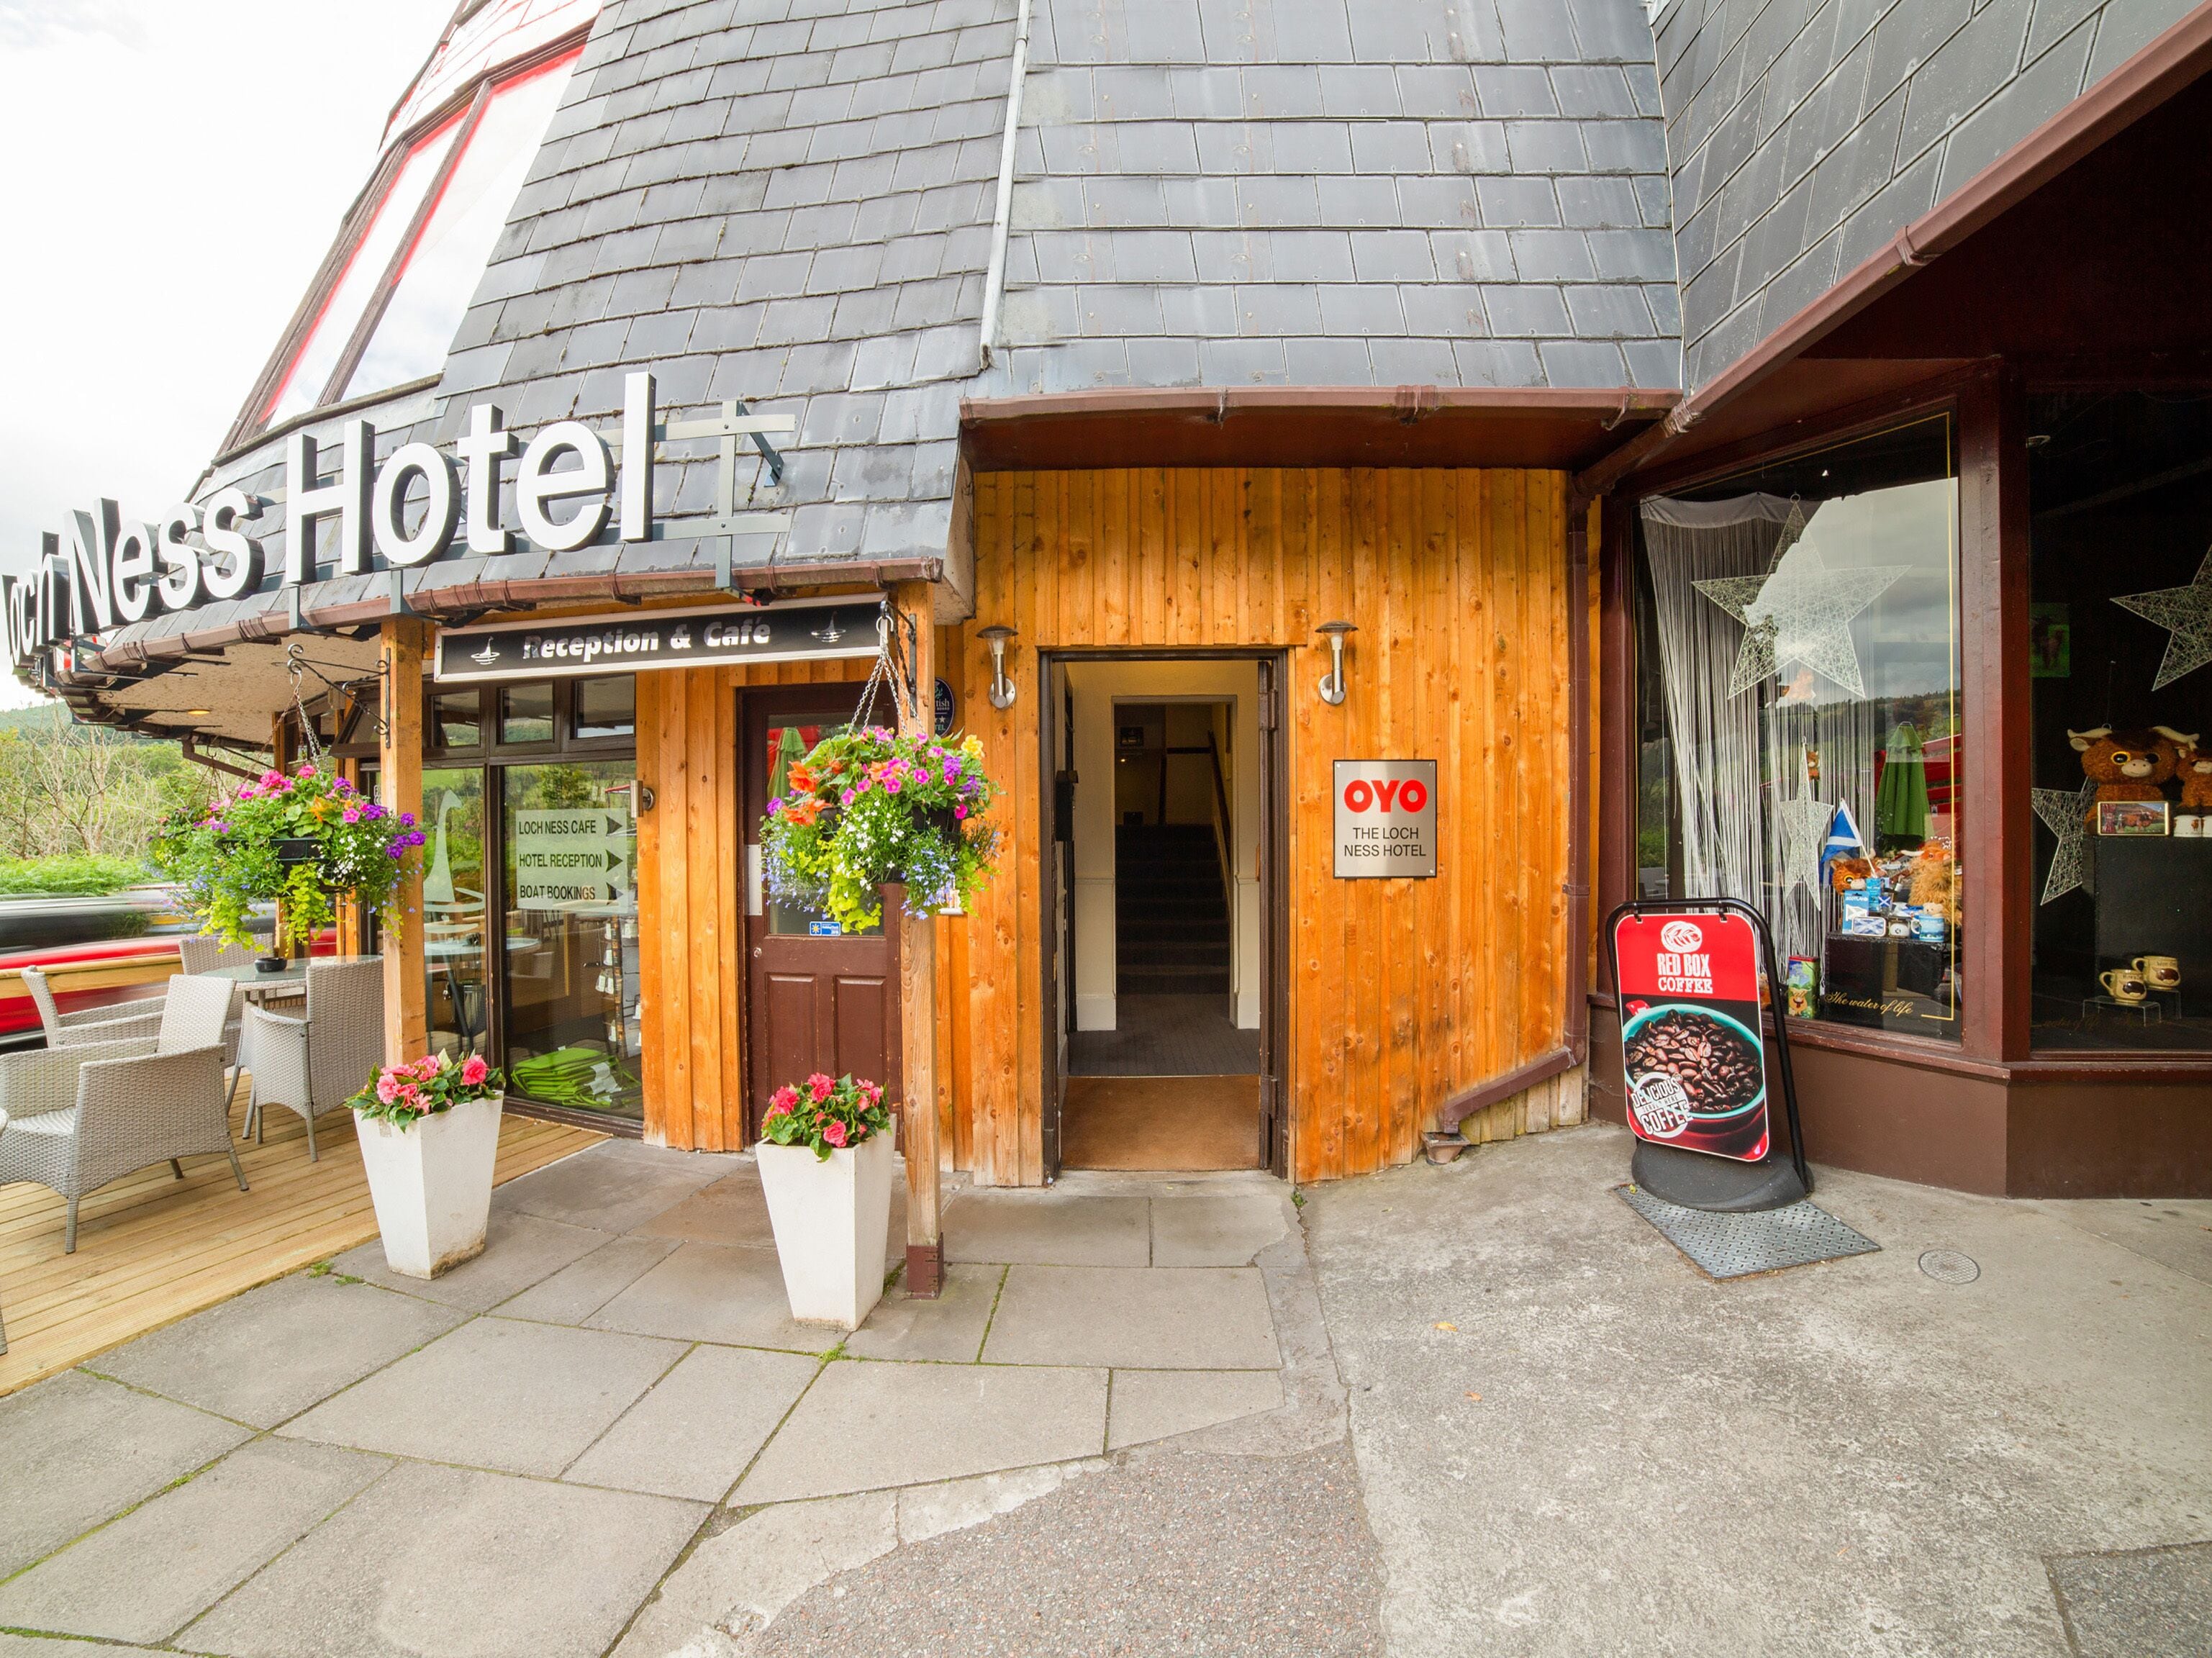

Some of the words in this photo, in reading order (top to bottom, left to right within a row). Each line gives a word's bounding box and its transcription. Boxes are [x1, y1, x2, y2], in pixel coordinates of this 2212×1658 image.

[63, 488, 265, 636] Ness
[286, 371, 657, 584] Hotel
[522, 628, 659, 663] Reception
[670, 624, 692, 649] &
[704, 616, 771, 648] Café
[1343, 779, 1428, 813] OYO
[519, 821, 543, 835] LOCH
[545, 820, 568, 835] NESS
[571, 820, 597, 834] CAFE
[1353, 828, 1379, 839] THE
[1382, 828, 1419, 839] LOCH
[519, 853, 548, 867] HOTEL
[550, 853, 602, 867] RECEPTION
[1344, 845, 1379, 856] NESS
[1383, 845, 1426, 856] HOTEL
[520, 885, 545, 898] BOAT
[547, 886, 596, 900] BOOKINGS
[1656, 953, 1682, 976] RED
[1683, 953, 1711, 977] BOX
[1658, 977, 1713, 994] COFFEE
[1824, 992, 1848, 1005] The
[1849, 998, 1880, 1010] water
[1880, 1000, 1895, 1015] of
[1893, 1001, 1914, 1016] life
[1631, 1077, 1680, 1107] DELICIOUS
[1641, 1100, 1694, 1135] COFFEE
